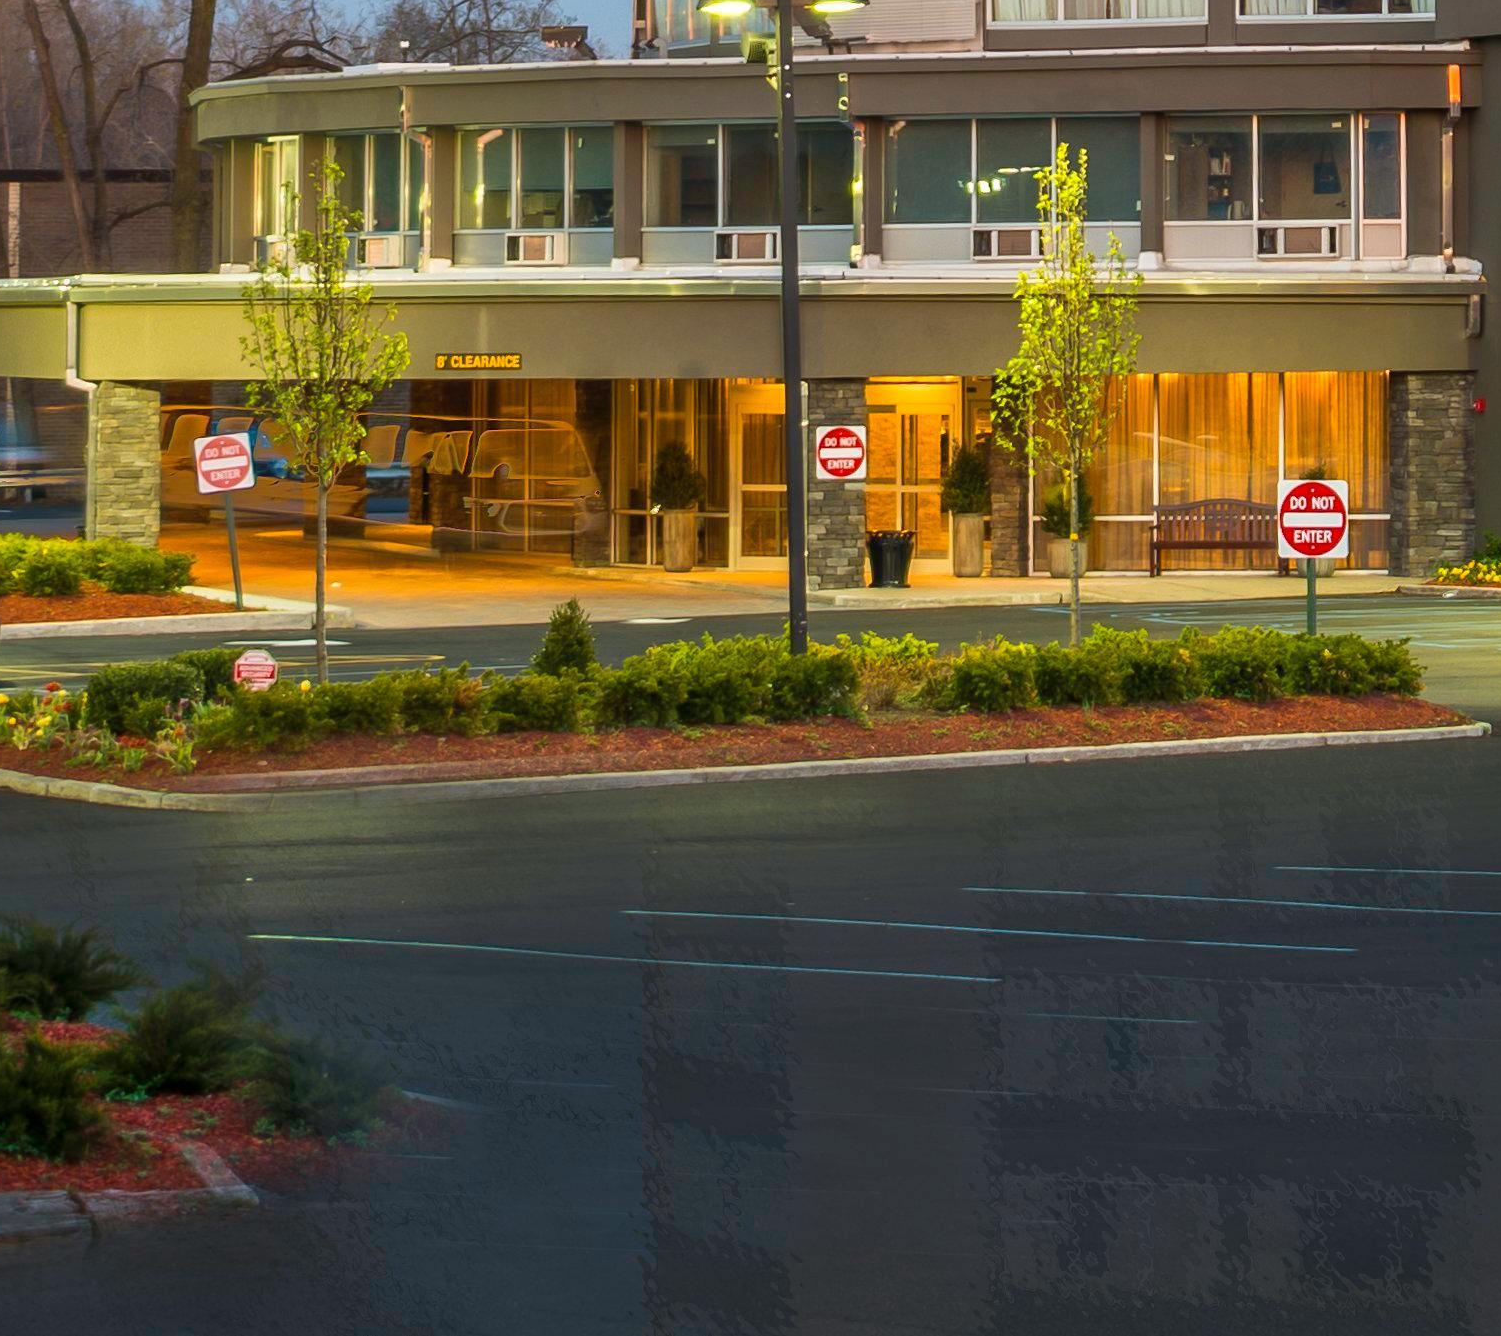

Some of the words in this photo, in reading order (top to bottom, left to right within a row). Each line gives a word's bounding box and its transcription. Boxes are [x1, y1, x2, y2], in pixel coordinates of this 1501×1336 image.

[451, 355, 520, 368] CLEARANCE
[825, 438, 838, 447] DO
[839, 437, 857, 447] NOT
[204, 448, 219, 459] DO
[221, 445, 241, 456] NOT
[827, 460, 855, 470] ENTER
[210, 469, 242, 482] ENTER
[1289, 496, 1307, 510] DO
[1311, 496, 1336, 509] NOT
[1293, 530, 1333, 544] ENTER
